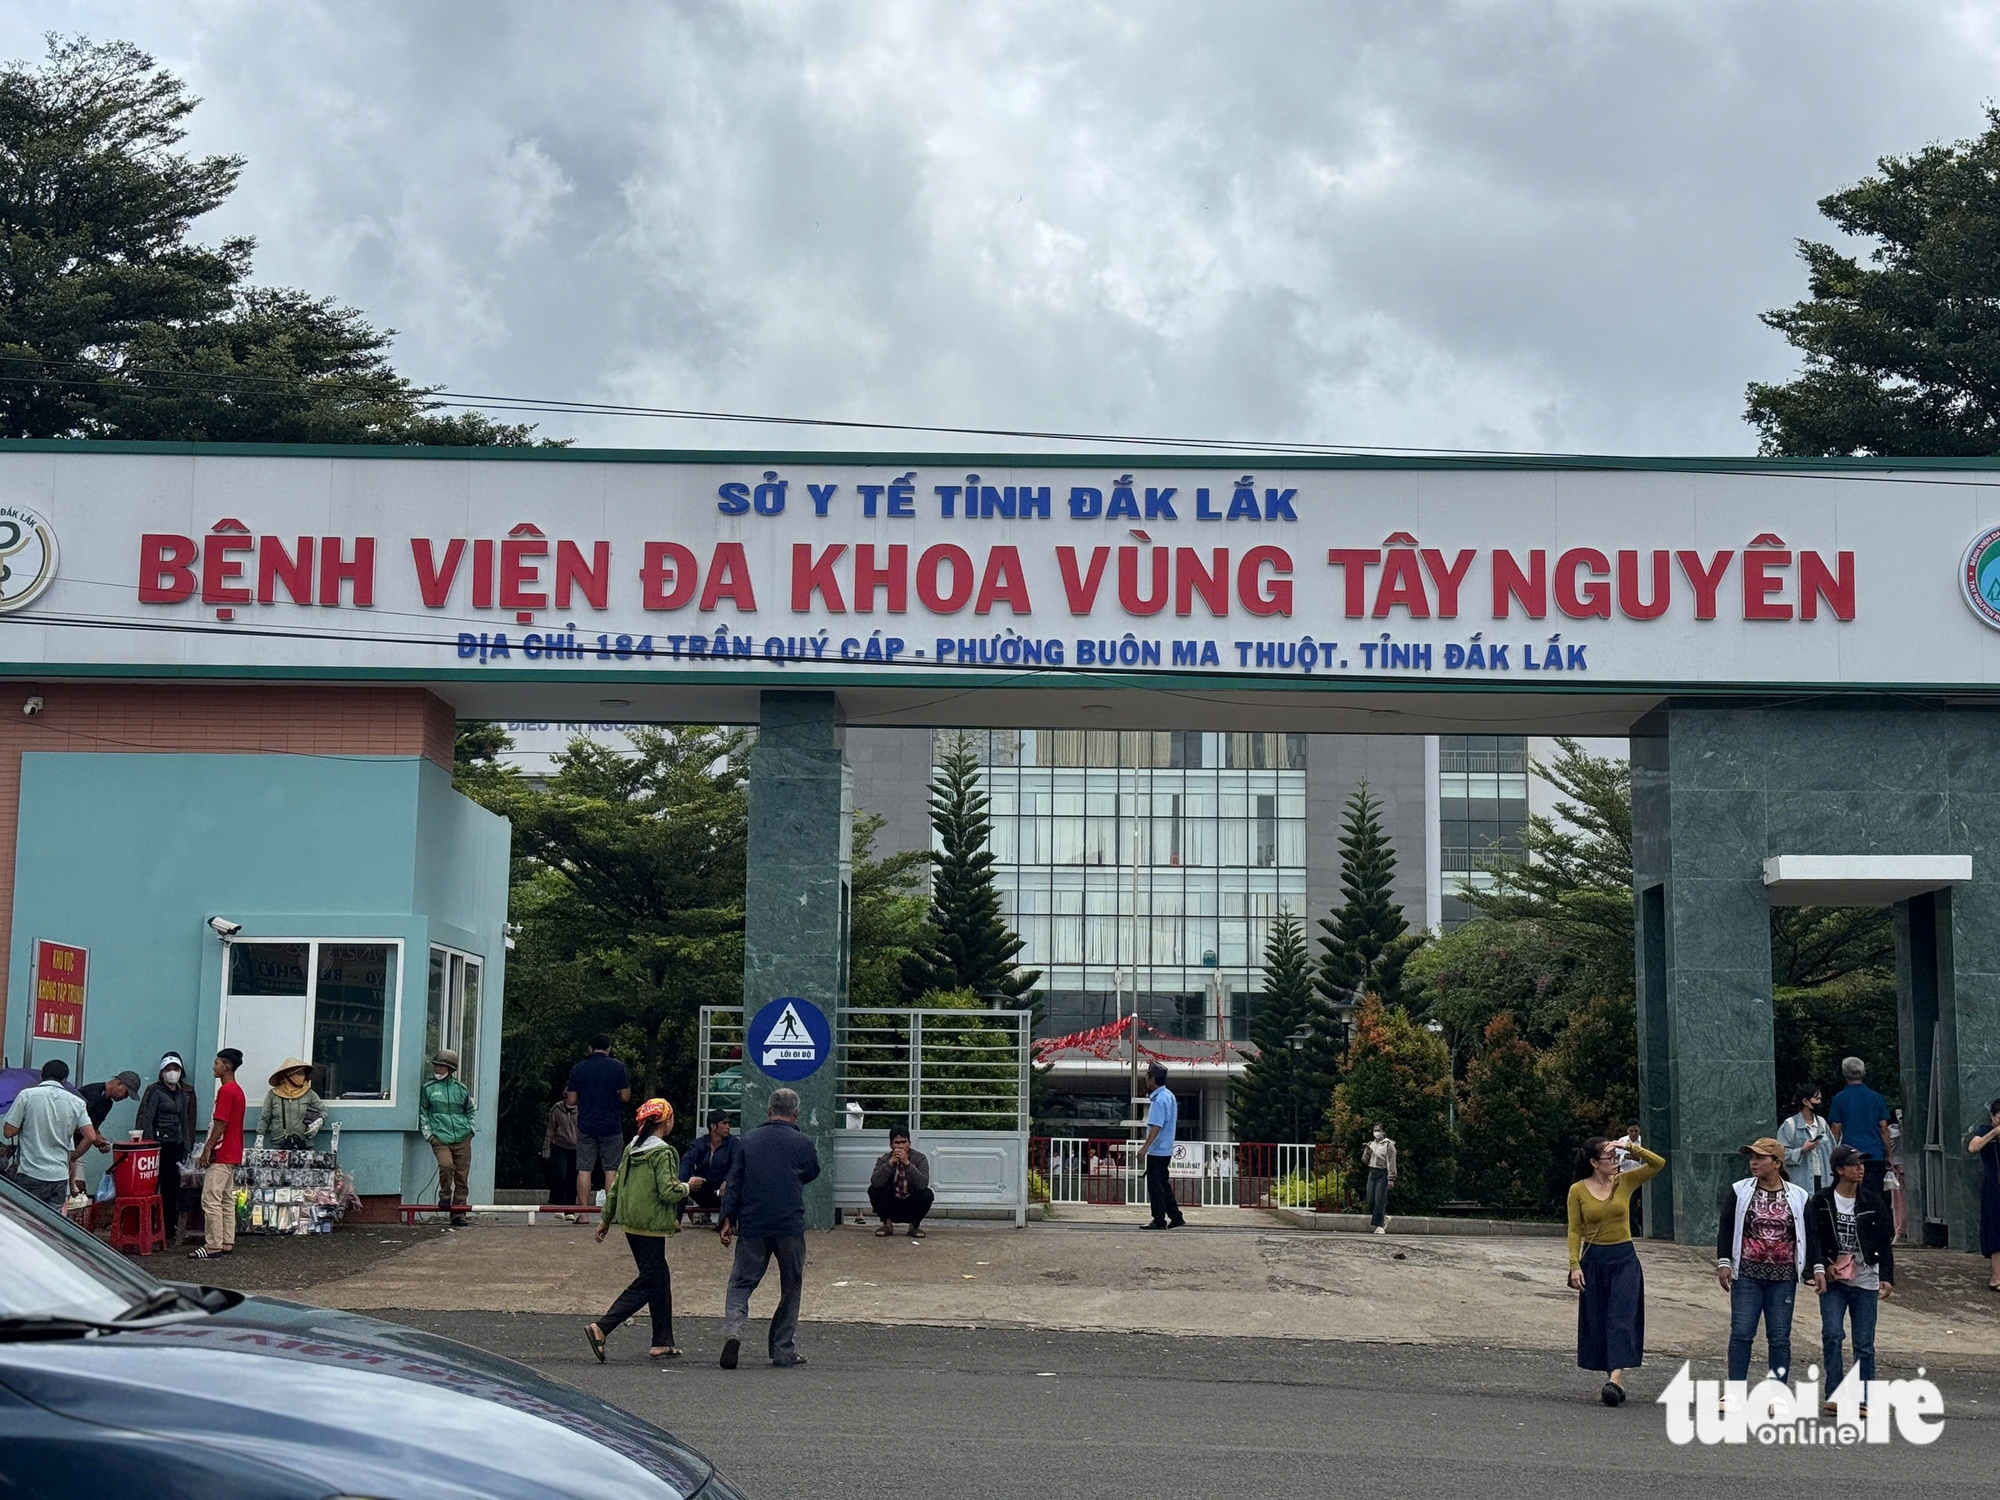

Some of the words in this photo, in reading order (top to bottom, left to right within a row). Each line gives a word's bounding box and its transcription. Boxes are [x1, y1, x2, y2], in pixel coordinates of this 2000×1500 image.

[718, 471, 788, 515] SỞ
[807, 484, 838, 516] Y
[857, 472, 917, 518] TẾ
[934, 474, 1050, 519] TỈNH
[1068, 474, 1178, 520] ĐẮK
[1196, 475, 1298, 521] LẮK
[138, 518, 377, 620] BỆNH
[410, 523, 610, 624] VIỆN
[640, 541, 757, 612] ĐA
[791, 541, 1031, 615] KHOA
[1055, 529, 1294, 617] VÙNG
[1327, 531, 1477, 619] TÂY
[1492, 533, 1856, 620] NGUYÊN
[596, 633, 655, 660] 184
[667, 623, 752, 661] TRẦN
[763, 628, 829, 666] QUÝ
[841, 629, 905, 662] CÁP
[936, 627, 1065, 665] PHƯỜNG
[1076, 632, 1161, 666] BUÔN
[1172, 640, 1220, 666] MA
[1360, 633, 1432, 670] TỈNH
[1444, 632, 1510, 669] ĐẮK
[1523, 633, 1588, 671] LẮK
